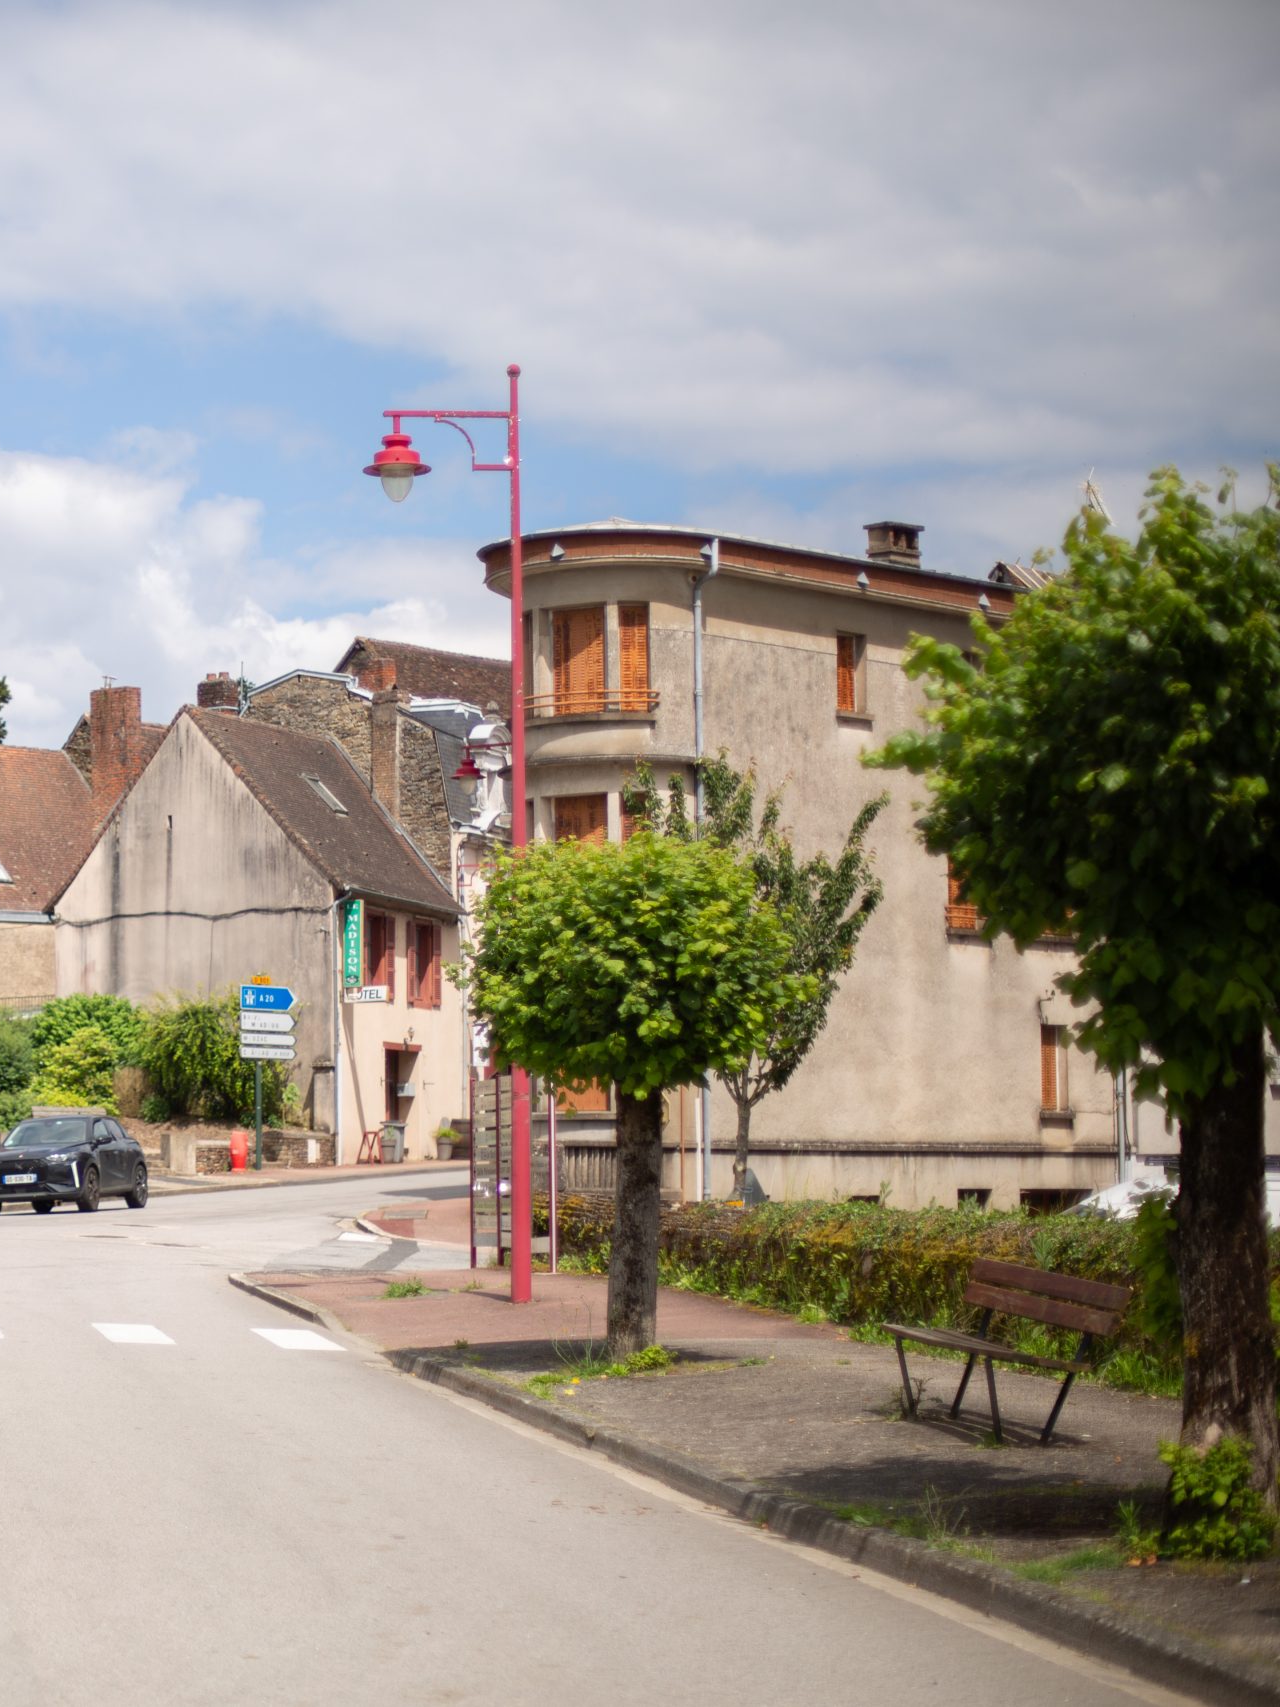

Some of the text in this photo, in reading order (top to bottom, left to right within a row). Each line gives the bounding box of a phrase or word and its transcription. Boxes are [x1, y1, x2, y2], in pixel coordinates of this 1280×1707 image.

[347, 914, 359, 973] MADISON
[259, 994, 275, 1003] A 20
[354, 988, 382, 1000] OTEL
